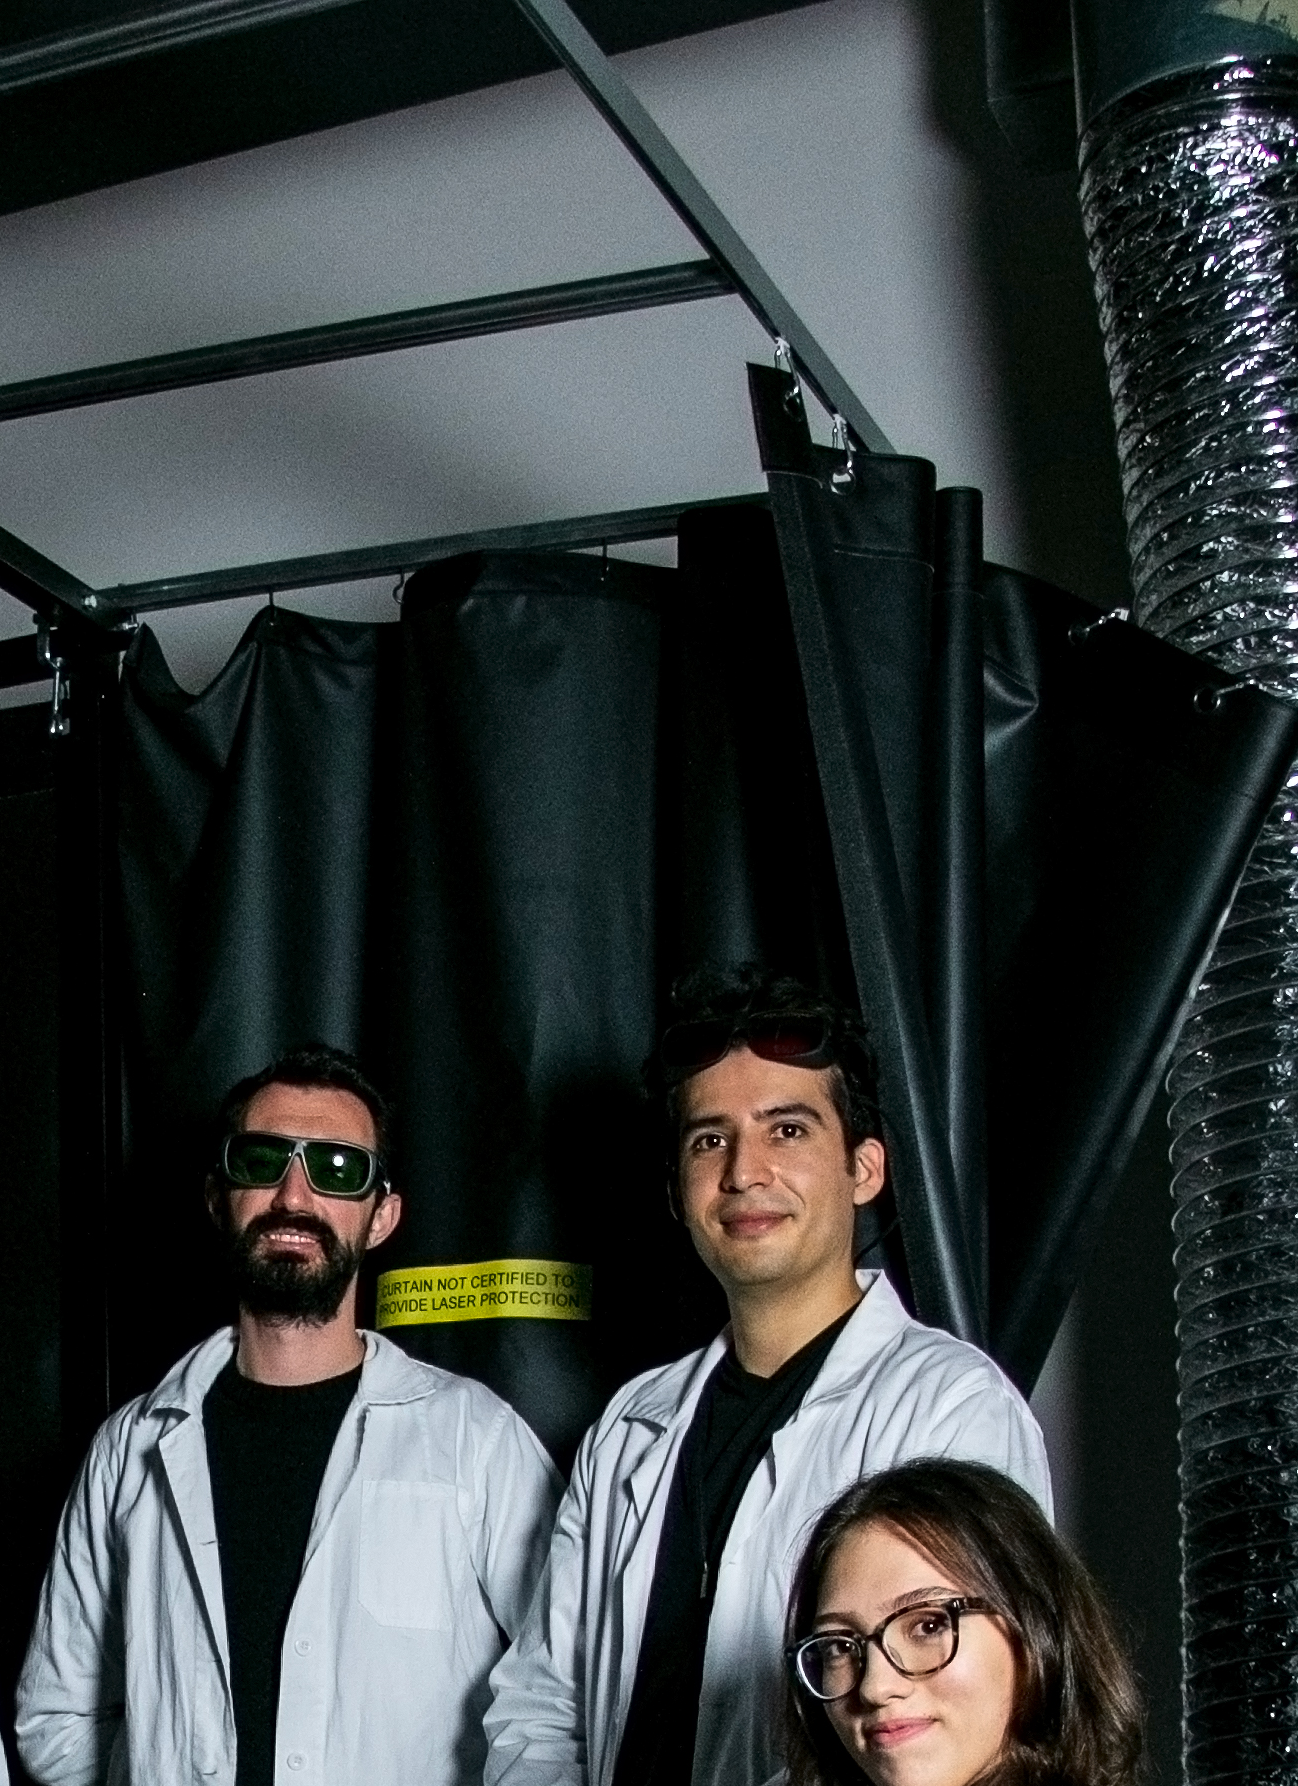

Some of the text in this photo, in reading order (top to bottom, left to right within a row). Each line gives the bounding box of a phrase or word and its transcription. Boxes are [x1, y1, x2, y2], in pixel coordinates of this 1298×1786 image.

[382, 1271, 575, 1298] CURTAIN NOT CERTIFIED TO
[379, 1290, 580, 1316] PROVIDE LASER PROTECTION
